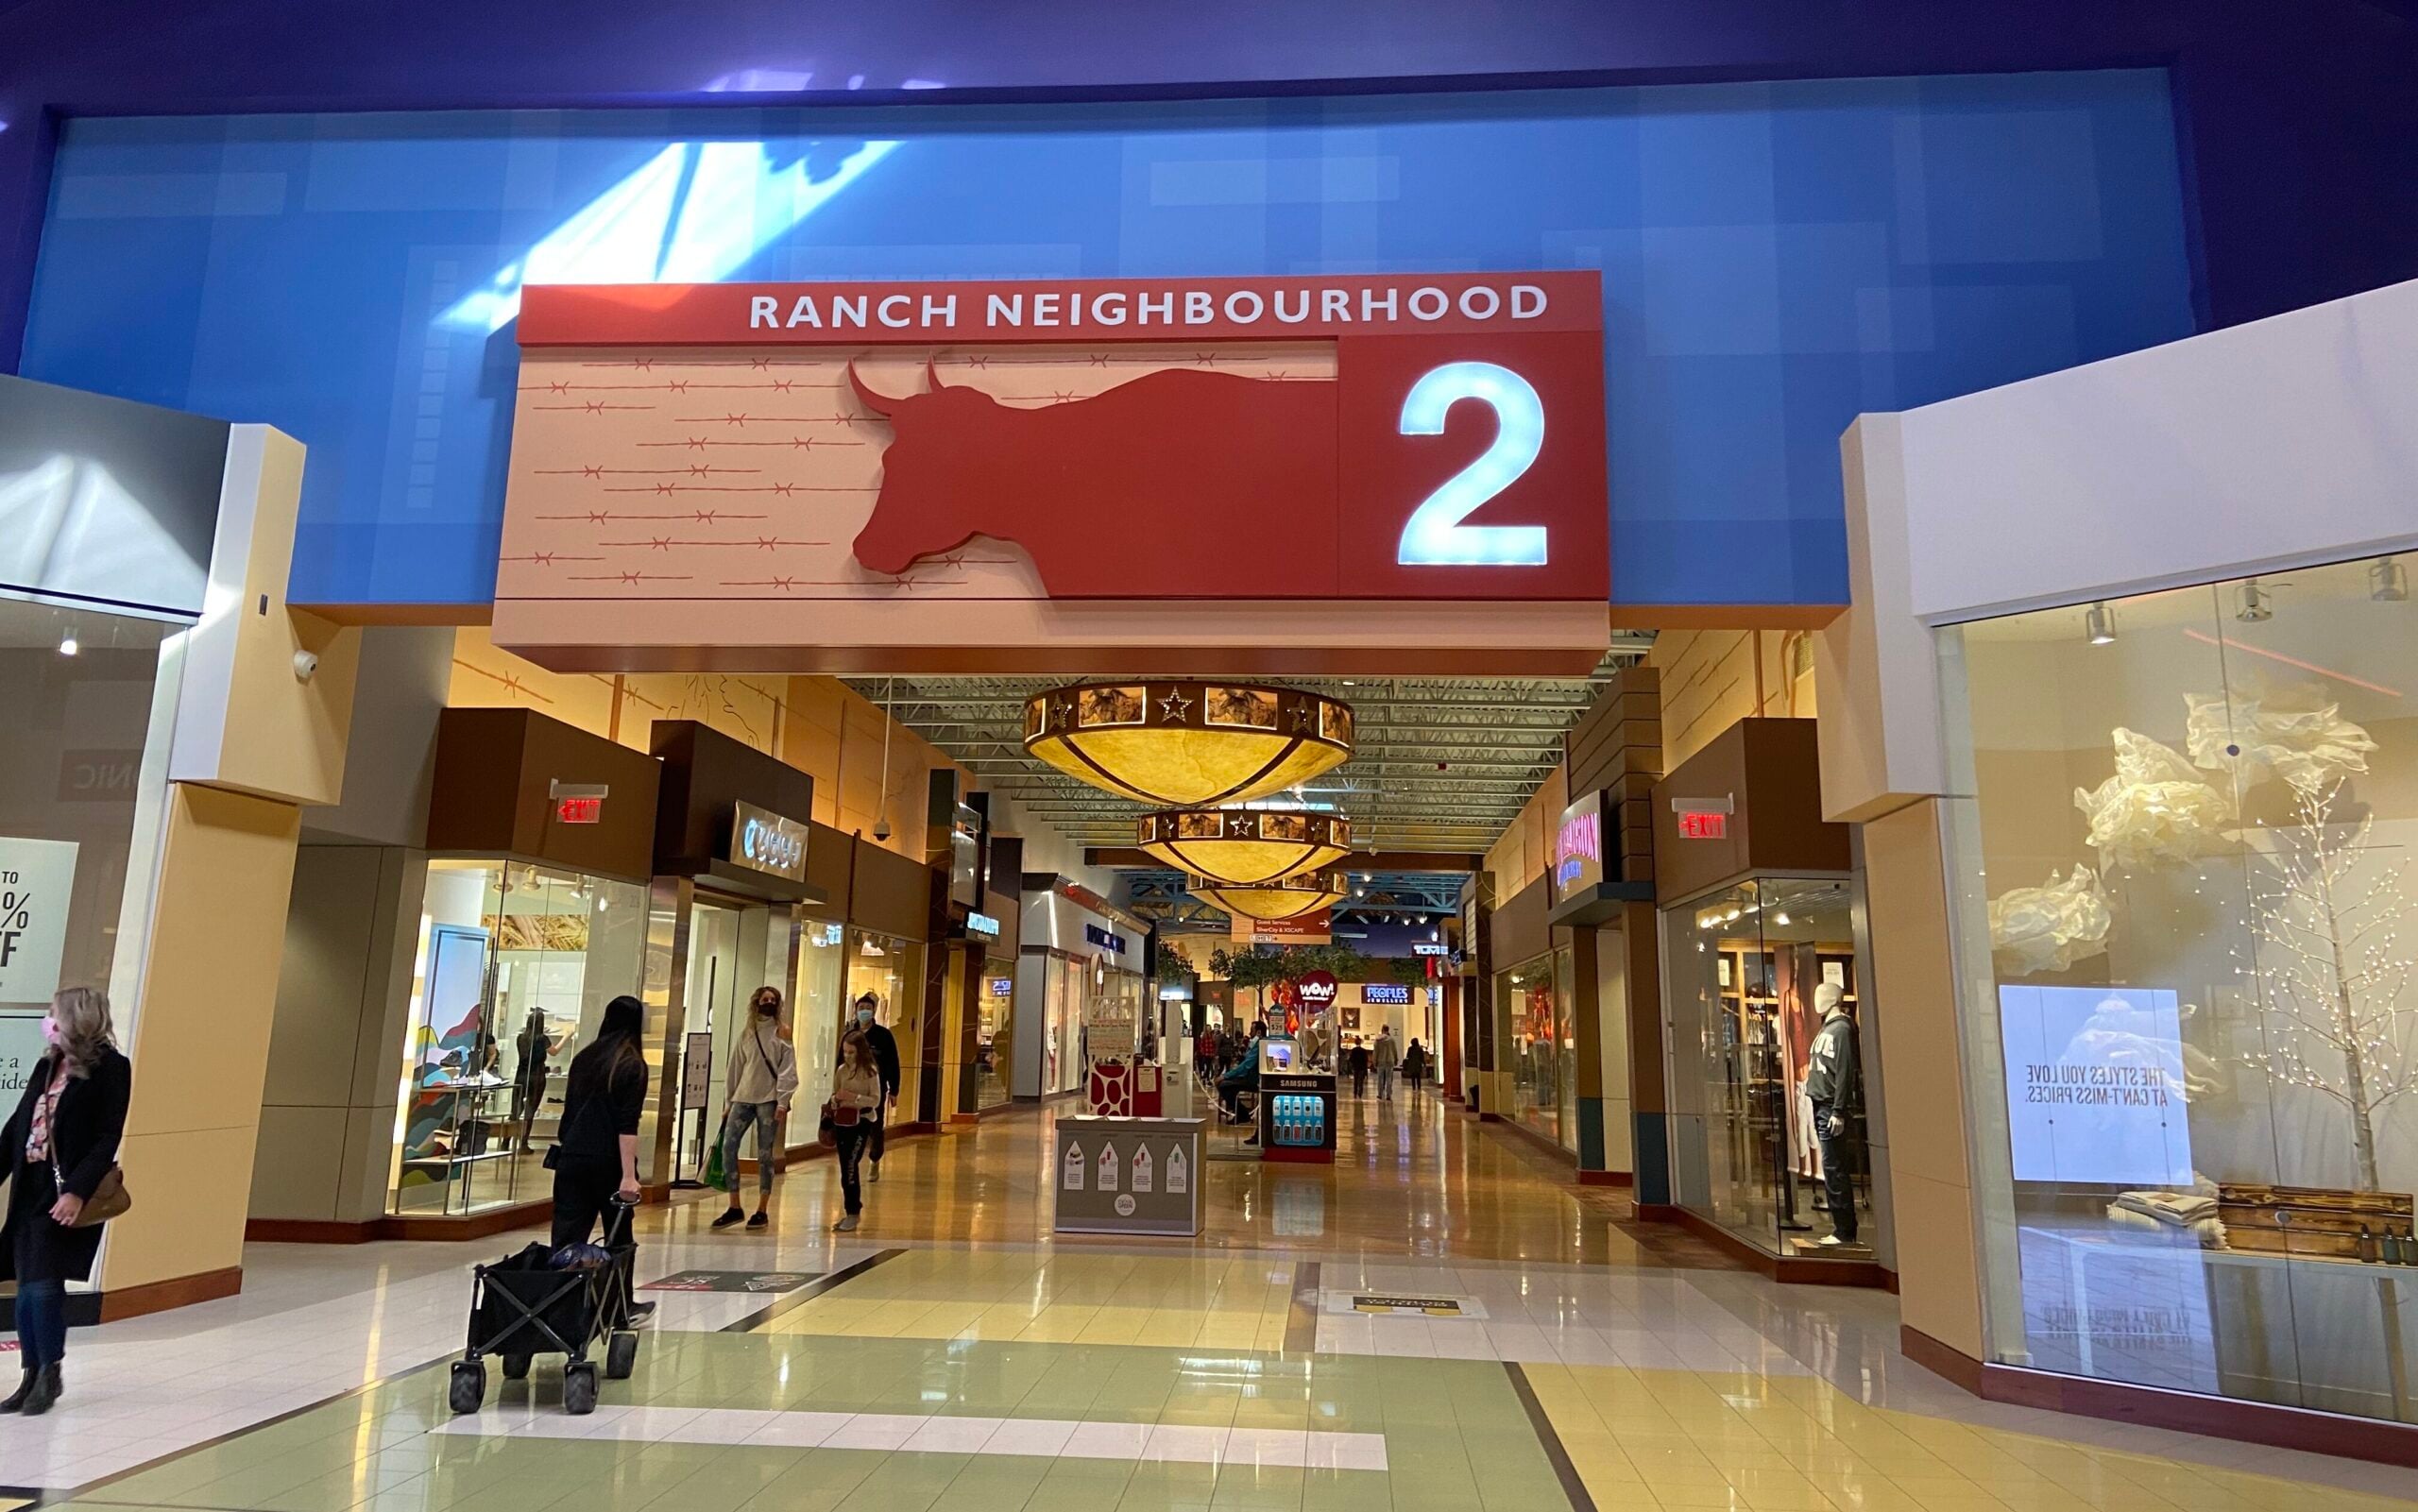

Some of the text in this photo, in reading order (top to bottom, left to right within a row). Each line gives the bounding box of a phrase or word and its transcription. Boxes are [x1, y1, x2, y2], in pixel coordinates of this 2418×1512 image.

[750, 284, 1550, 330] RANCH NEIGHBOURHOOD
[1397, 362, 1548, 567] 2
[1686, 812, 1725, 837] EXIT
[2, 871, 19, 884] TO
[1367, 987, 1408, 998] PEOPLES
[1280, 1079, 1318, 1088] SAMSUNG
